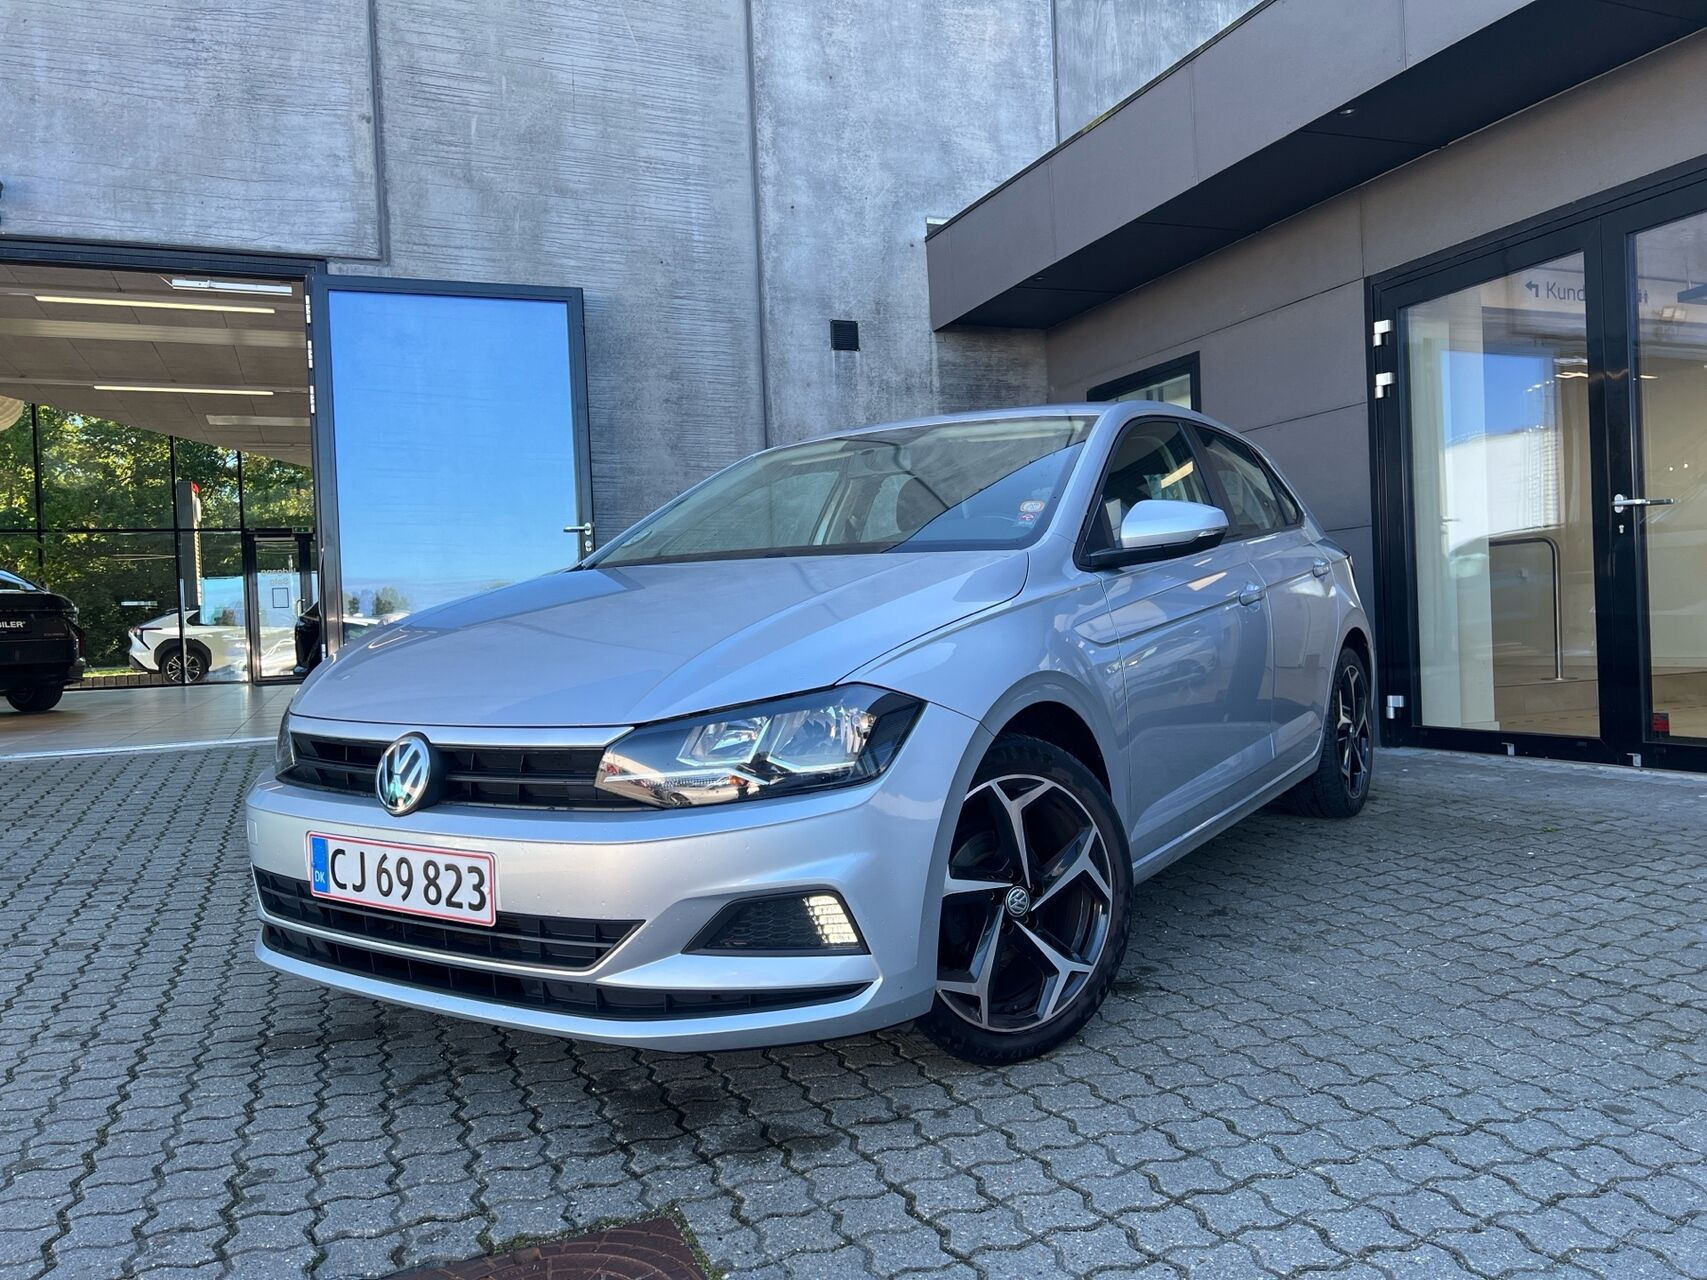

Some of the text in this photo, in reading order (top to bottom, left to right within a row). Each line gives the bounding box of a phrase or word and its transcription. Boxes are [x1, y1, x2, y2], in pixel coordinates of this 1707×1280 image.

[314, 870, 325, 884] DK
[330, 848, 486, 912] CJ 69 823
